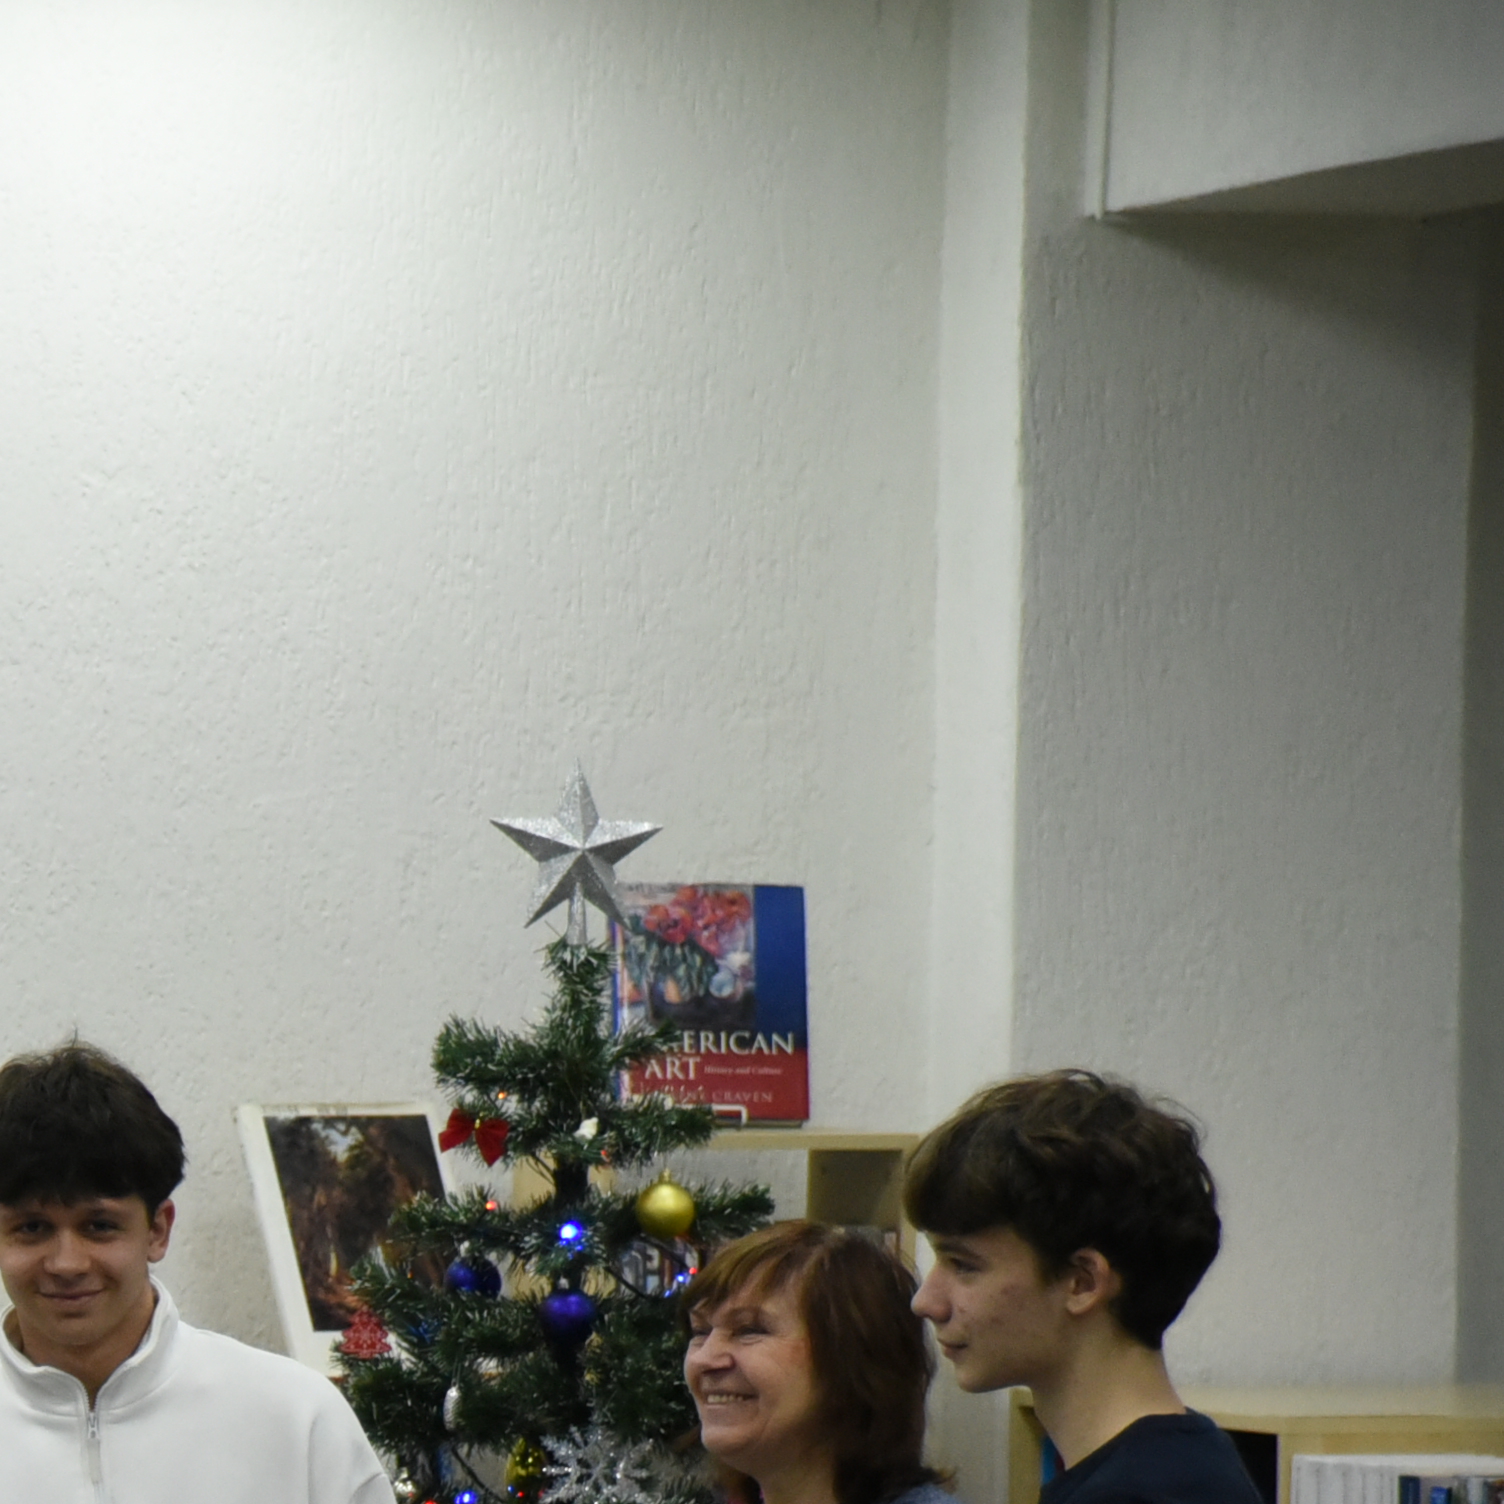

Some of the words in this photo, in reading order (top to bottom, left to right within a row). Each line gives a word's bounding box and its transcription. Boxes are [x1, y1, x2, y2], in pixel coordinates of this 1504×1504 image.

[672, 1029, 796, 1056] ERICAN
[644, 1056, 701, 1081] ART
[711, 1090, 773, 1103] CRAVEN
